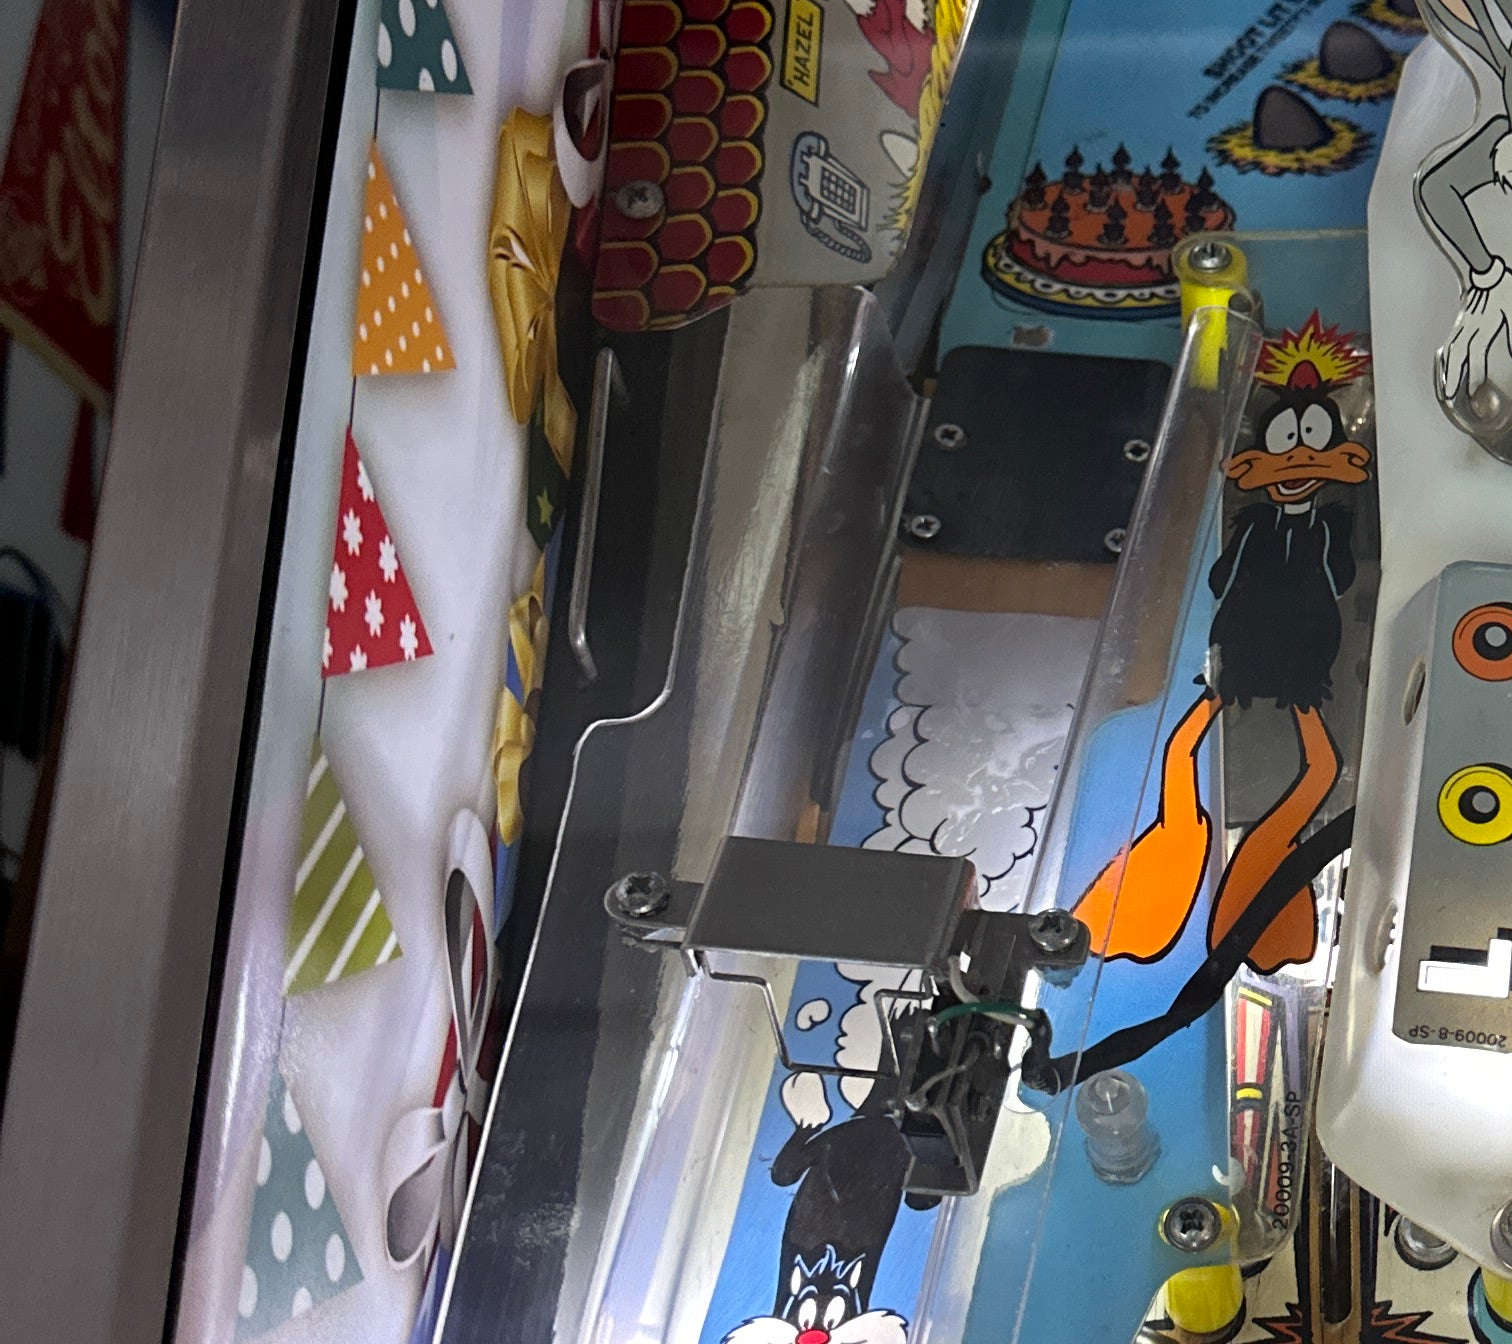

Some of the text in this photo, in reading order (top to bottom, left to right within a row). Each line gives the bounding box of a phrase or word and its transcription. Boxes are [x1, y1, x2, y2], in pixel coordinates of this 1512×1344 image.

[792, 6, 817, 87] HAZEL
[1408, 1024, 1507, 1048] 20009-8-SP
[1272, 1091, 1301, 1230] 20009-3A-SP
